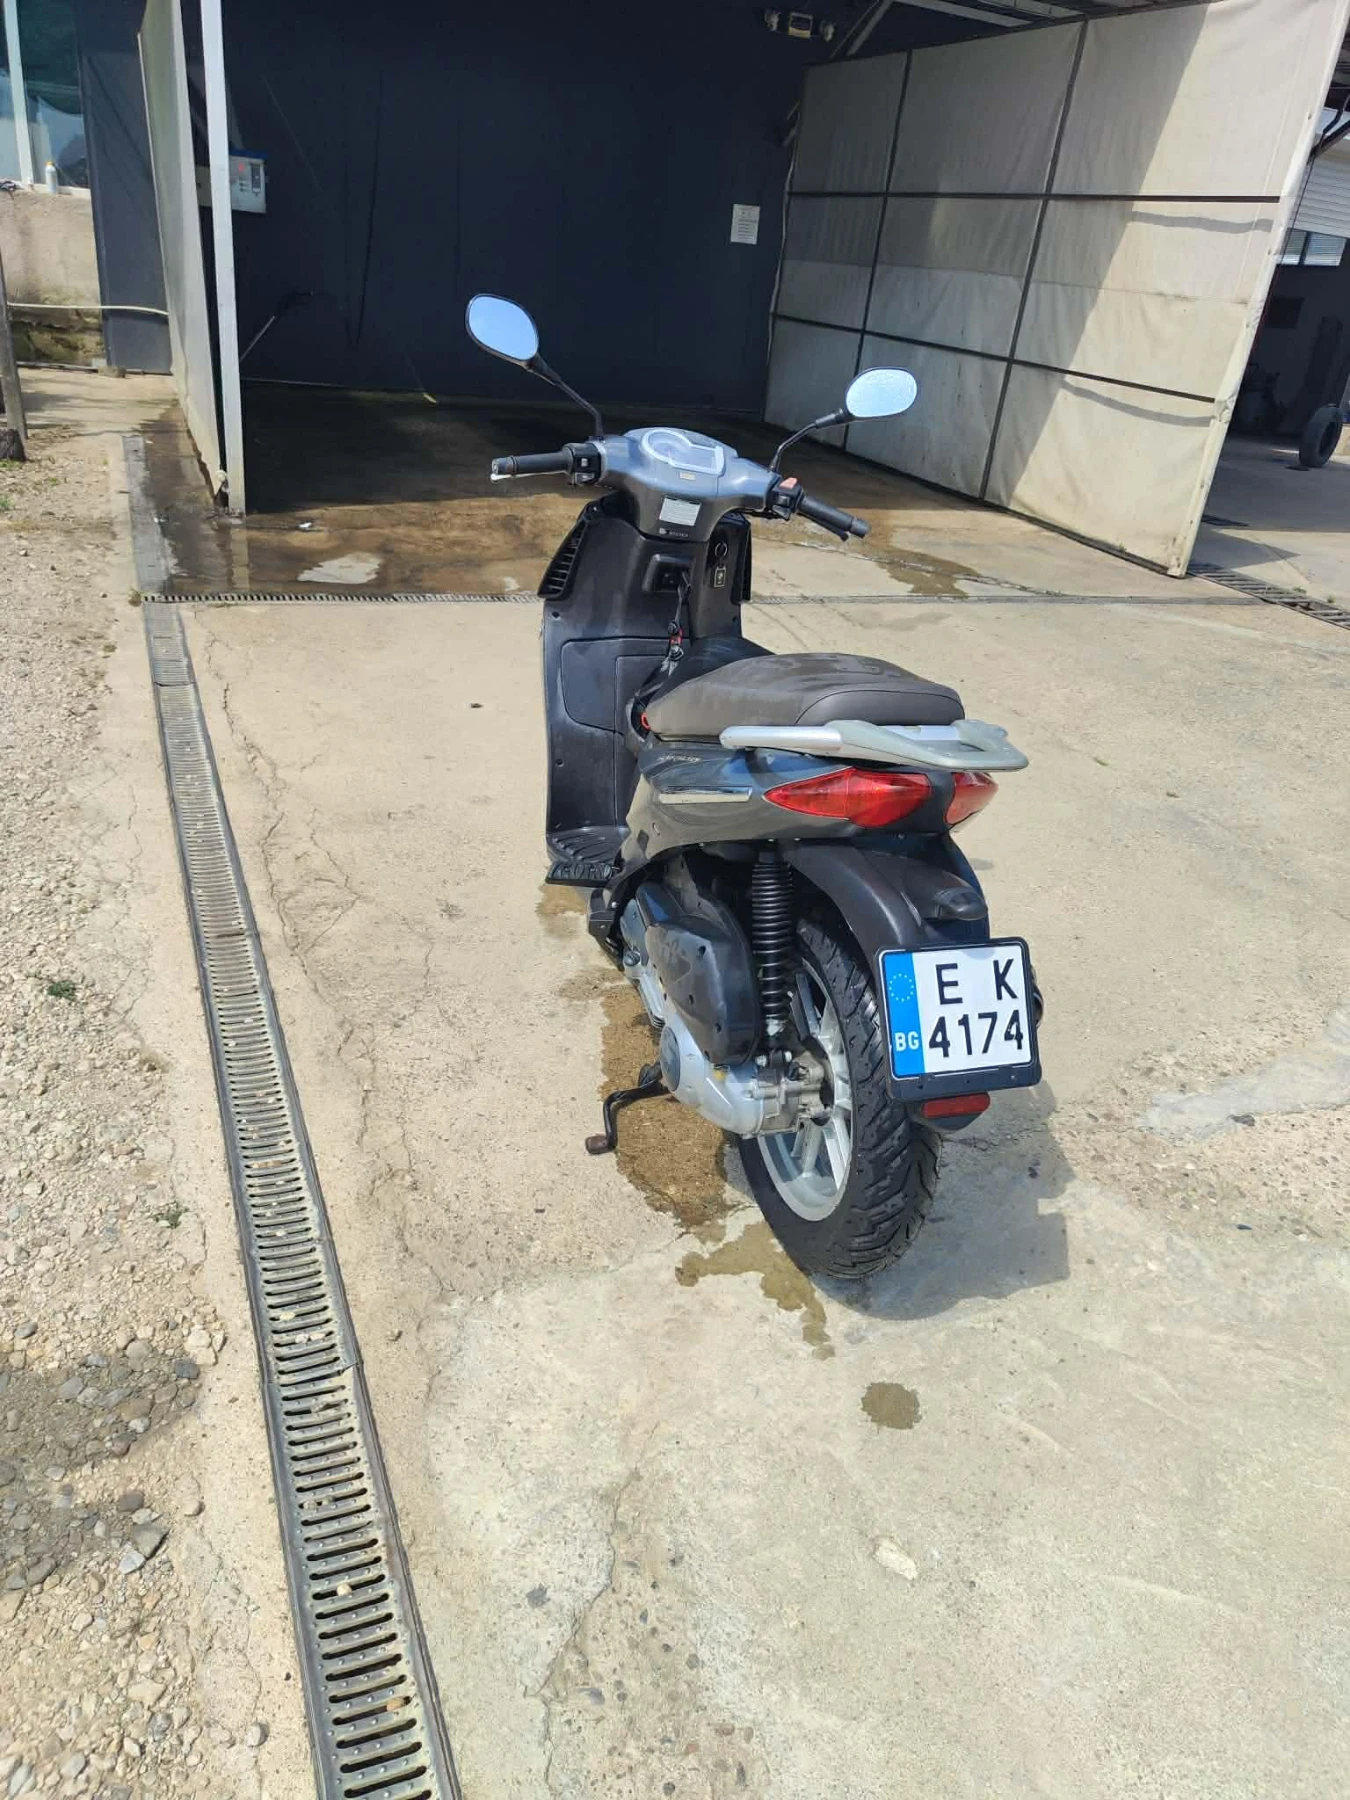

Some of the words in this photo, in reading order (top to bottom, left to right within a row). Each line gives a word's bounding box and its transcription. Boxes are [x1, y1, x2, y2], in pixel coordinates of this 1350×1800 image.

[935, 962, 963, 1005] E
[992, 958, 1018, 1001] K
[894, 1030, 920, 1052] BG
[928, 1009, 1024, 1058] 4174
